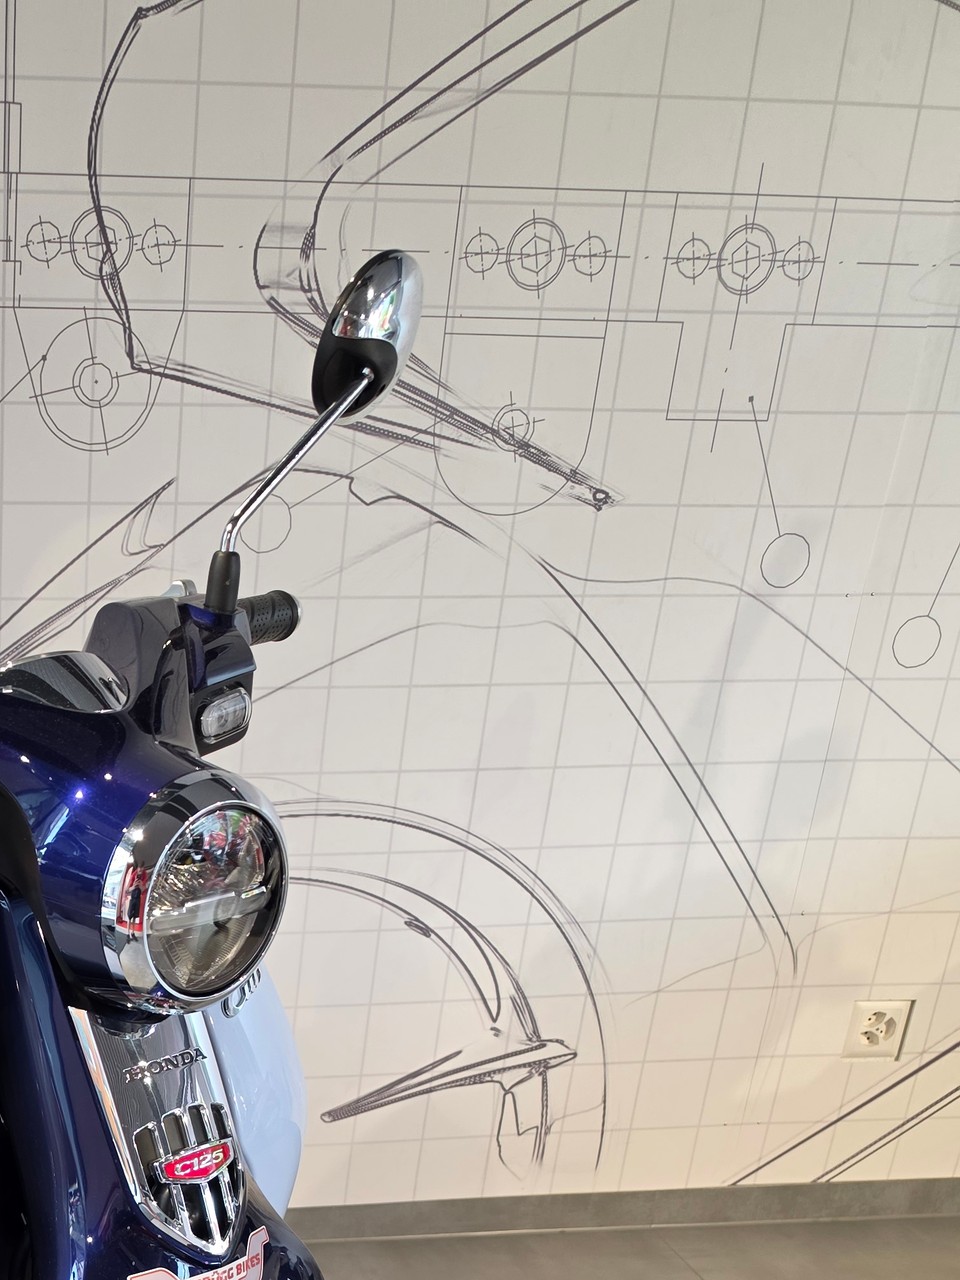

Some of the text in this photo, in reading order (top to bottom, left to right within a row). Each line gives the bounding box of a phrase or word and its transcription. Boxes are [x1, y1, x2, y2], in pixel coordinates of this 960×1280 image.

[122, 1047, 208, 1084] HONDA
[173, 1148, 224, 1176] C125
[235, 1253, 261, 1277] BIKES
